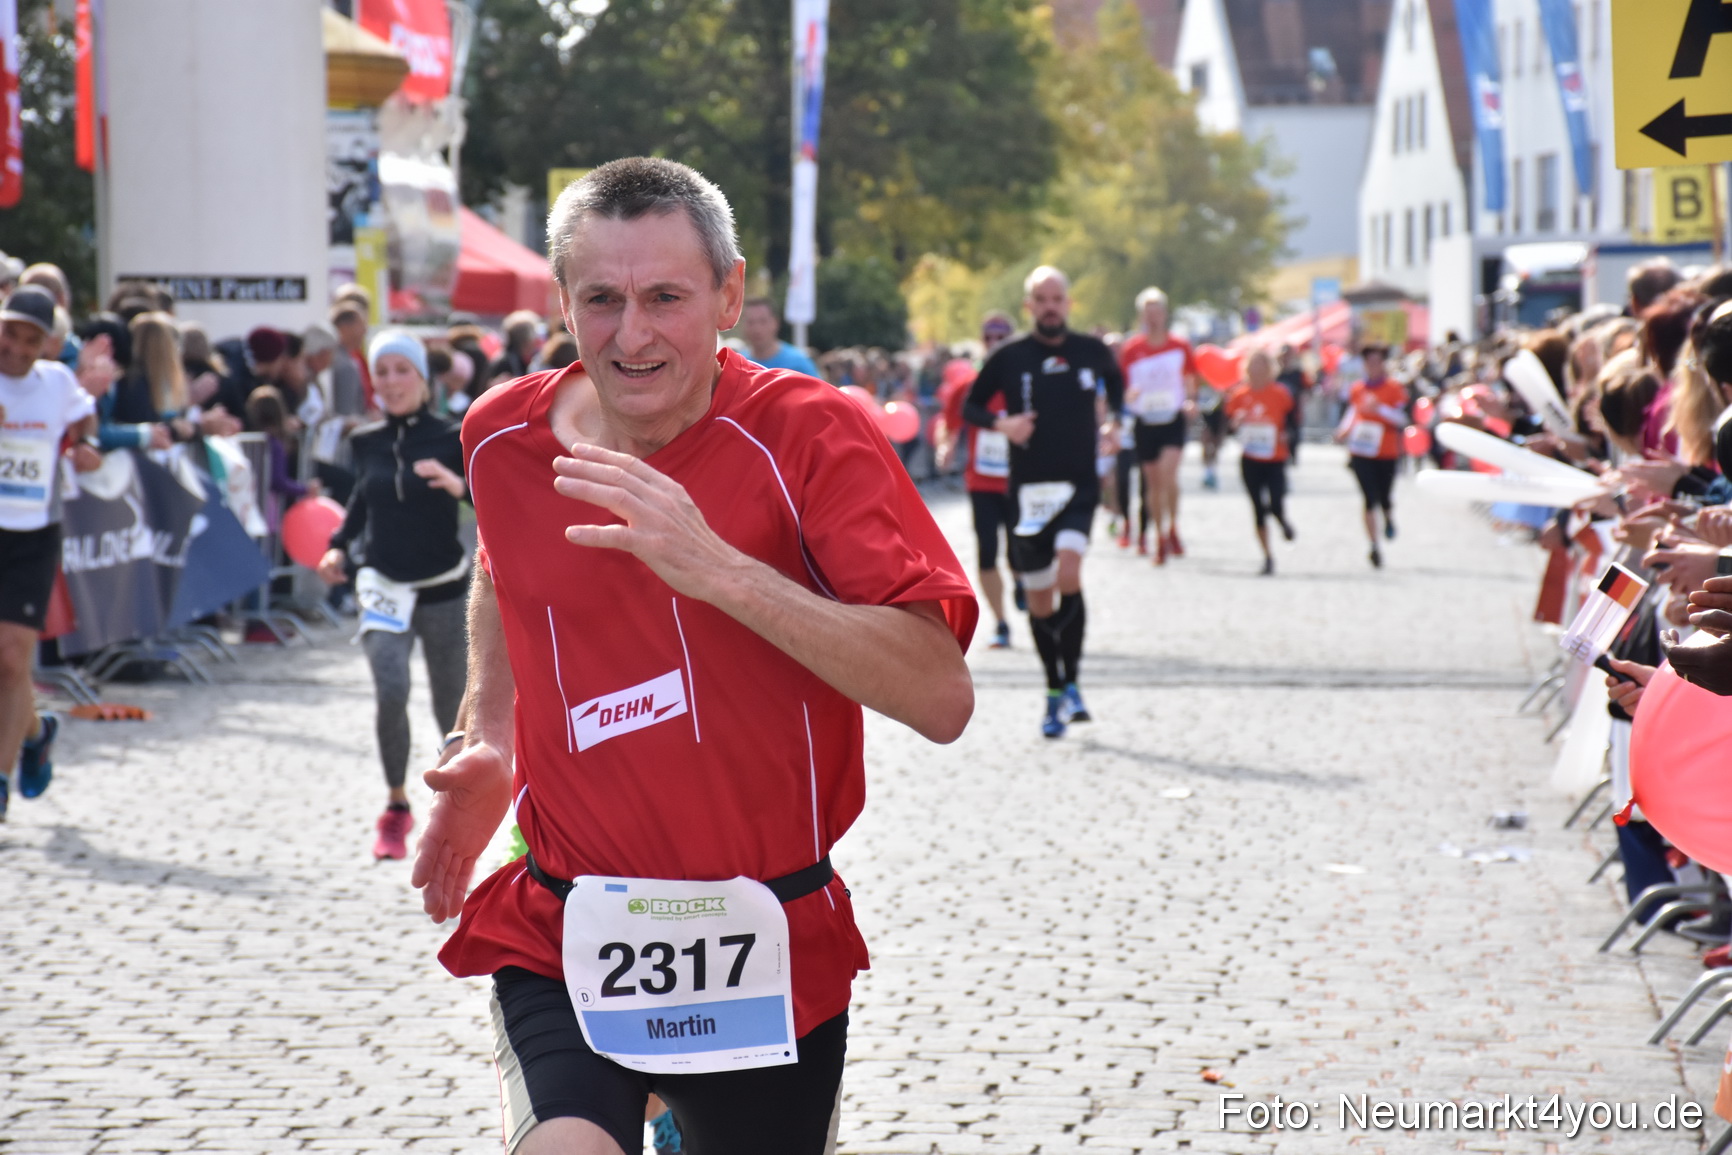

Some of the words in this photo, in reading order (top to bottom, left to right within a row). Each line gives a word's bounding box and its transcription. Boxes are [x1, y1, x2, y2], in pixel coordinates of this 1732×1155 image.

[1671, 176, 1703, 221] B
[599, 693, 655, 728] DEHN
[651, 897, 727, 915] BOCK
[598, 933, 756, 998] 2317
[581, 992, 589, 1003] D
[646, 1014, 717, 1040] Martin
